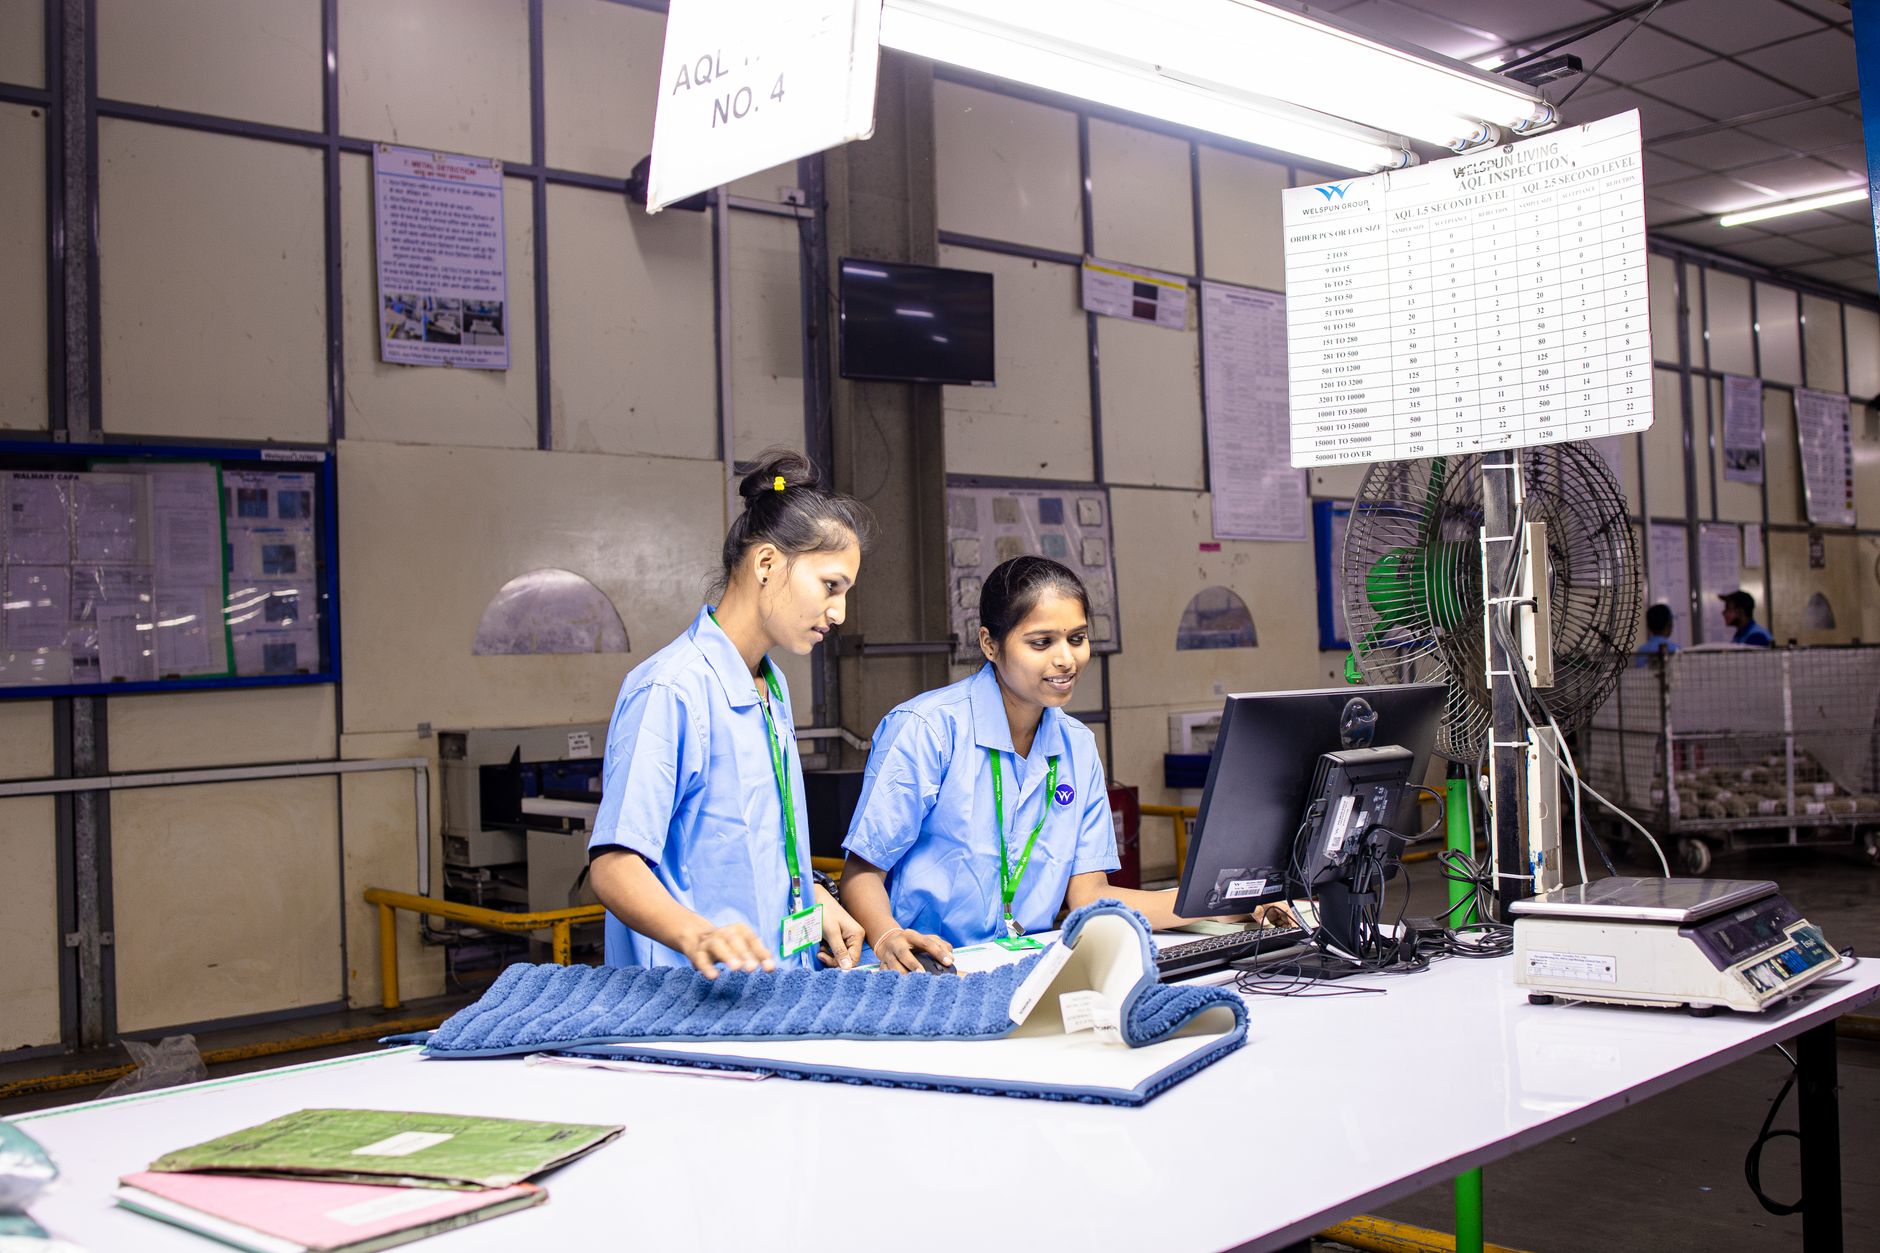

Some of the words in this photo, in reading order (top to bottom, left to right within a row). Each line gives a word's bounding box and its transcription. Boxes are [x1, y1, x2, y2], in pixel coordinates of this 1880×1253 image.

[672, 49, 729, 96] AQL
[712, 86, 759, 128] NO.
[770, 72, 786, 102] 4
[1453, 154, 1513, 179] WELSPUN
[1517, 143, 1559, 163] LIVING
[1459, 177, 1485, 191] AQL
[1489, 155, 1569, 183] INSPECTION
[1522, 182, 1542, 193] AQL
[1545, 177, 1556, 188] 2.5
[1559, 168, 1600, 184] SECOND
[1602, 156, 1636, 174] LEVEL
[1303, 205, 1340, 215] WELSPUN
[1395, 211, 1414, 220] AQL
[1431, 198, 1472, 212] SECOND
[1475, 190, 1507, 204] LEVEL
[1290, 234, 1317, 243] ORDER
[1348, 227, 1362, 235] LOT
[13, 472, 54, 480] WALMART
[57, 473, 80, 481] CAPA
